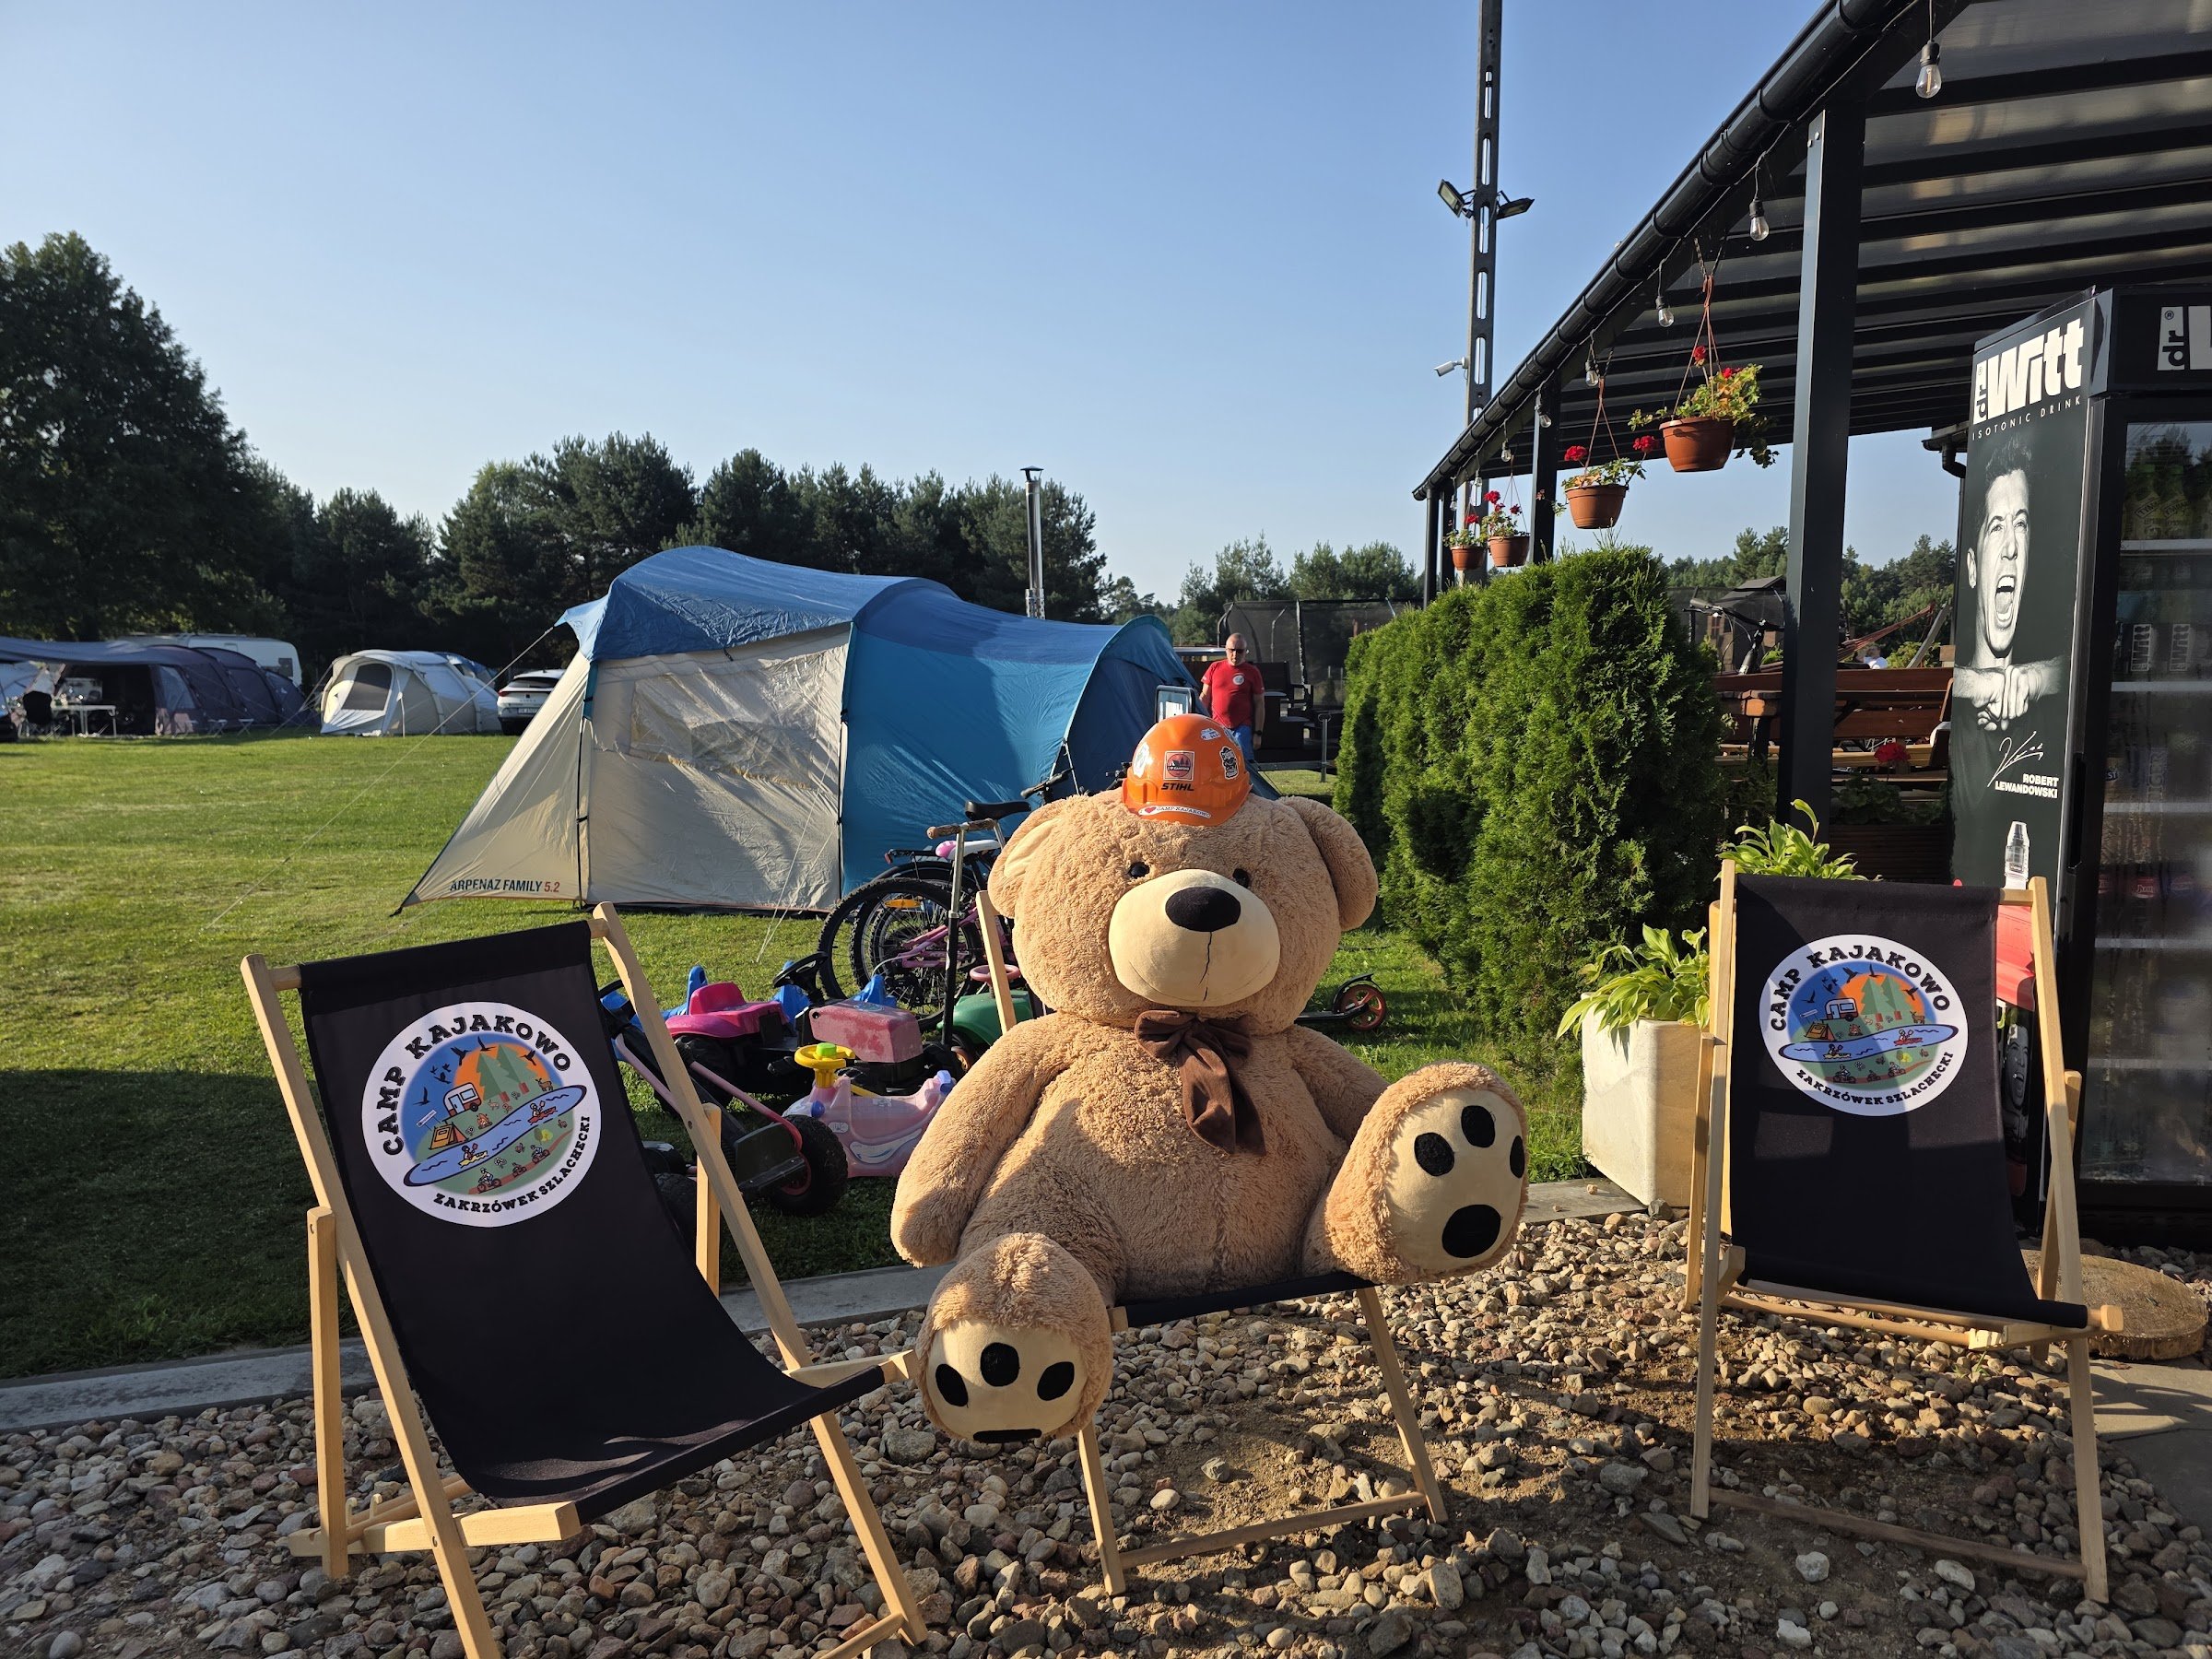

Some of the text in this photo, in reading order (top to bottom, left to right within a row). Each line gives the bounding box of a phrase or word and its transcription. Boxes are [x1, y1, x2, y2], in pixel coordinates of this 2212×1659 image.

[1987, 318, 2085, 420] Witt
[1971, 394, 2081, 441] ISOTONIC DRINK
[1160, 782, 1194, 792] STIHL
[1994, 780, 2058, 799] LEWANDOWSKI
[2022, 773, 2059, 787] ROBERT
[450, 878, 560, 893] ARPENAZ FAMILY 5.2
[1770, 945, 1950, 1031] CAMP KAJAKOWO
[376, 1014, 571, 1156] CAMP KAJAKOWO
[1796, 1052, 1955, 1105] ZAKRZÓWEK SZLACHECKI
[433, 1115, 591, 1213] ZAKRZÓWEK SZLACHECKI
